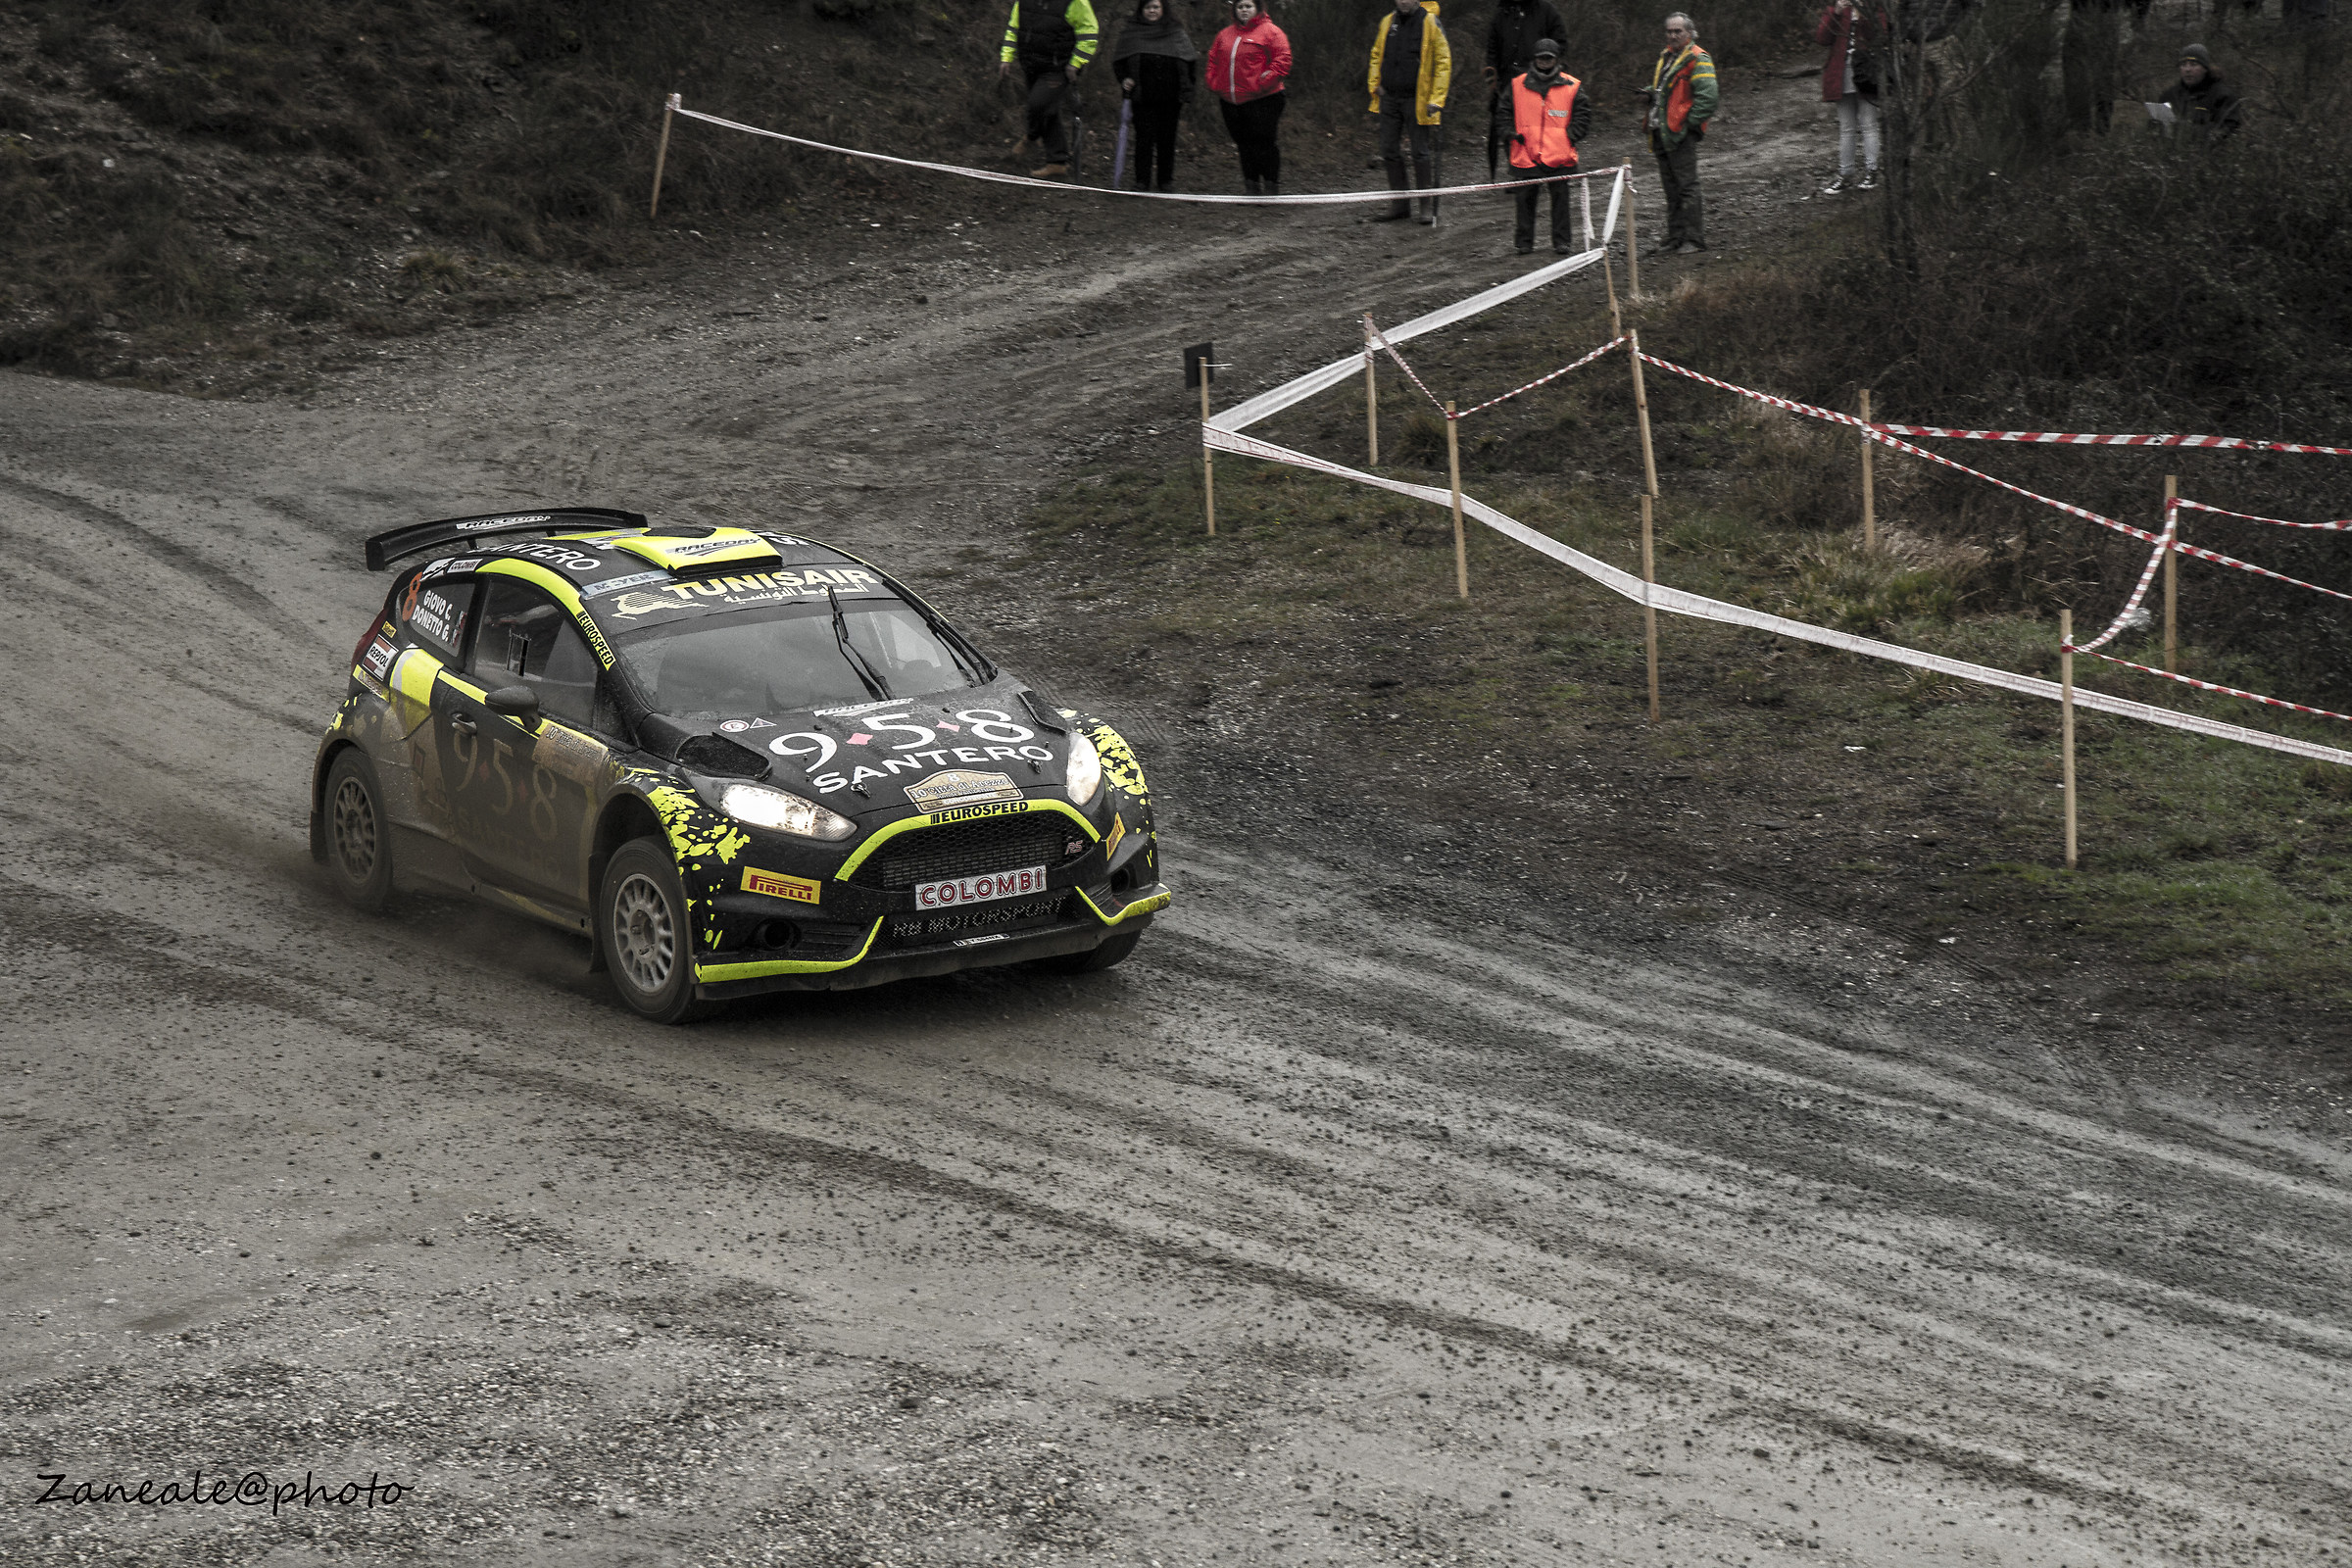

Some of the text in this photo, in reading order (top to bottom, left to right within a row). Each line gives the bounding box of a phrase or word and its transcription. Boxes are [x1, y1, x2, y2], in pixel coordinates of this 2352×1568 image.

[402, 571, 422, 621] 8
[661, 568, 882, 601] TUNISAIR
[423, 590, 453, 620] GIOVO C.
[412, 605, 444, 636] DONETTO
[441, 624, 450, 642] G.
[579, 614, 614, 665] EUROSPEED
[368, 646, 390, 667] REPSOL
[769, 709, 1035, 772] 9 5 8
[812, 745, 1054, 795] SANTERO
[948, 772, 960, 782] 8
[942, 801, 1029, 823] EUROSPEED
[749, 874, 813, 900] PIRELLI
[919, 867, 1045, 906] COLOMBI
